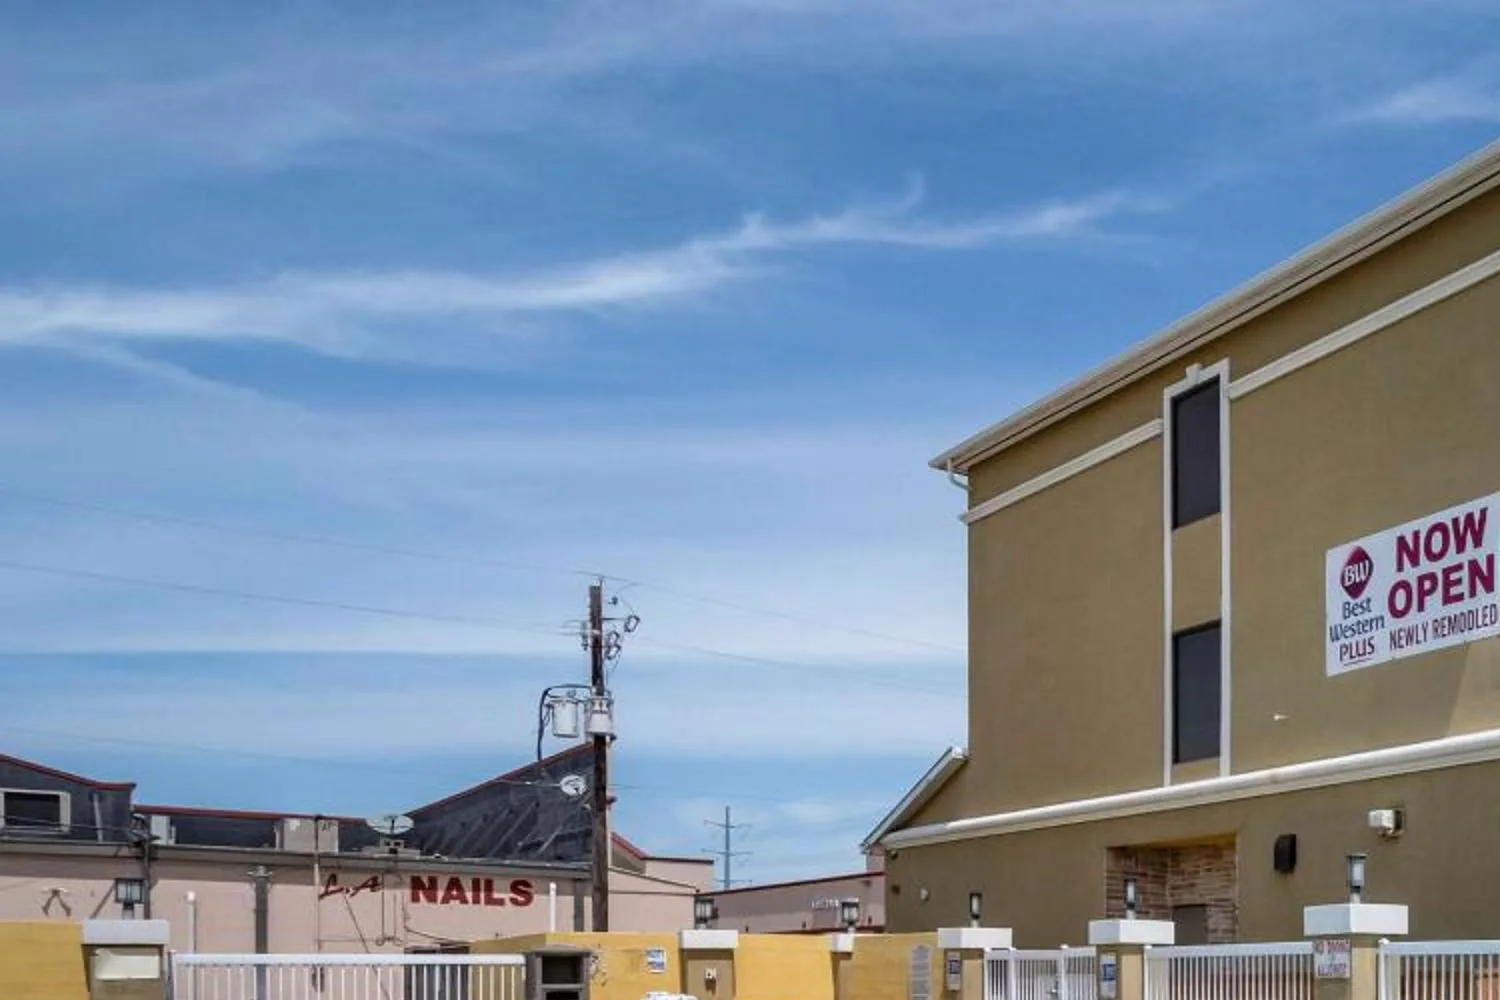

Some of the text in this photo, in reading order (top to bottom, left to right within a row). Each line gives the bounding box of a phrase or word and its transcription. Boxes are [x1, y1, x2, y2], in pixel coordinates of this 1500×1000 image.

[1395, 507, 1488, 573] NOW
[1343, 559, 1370, 587] BW
[1387, 553, 1495, 619] OPEN
[1343, 597, 1372, 620] Best
[1330, 615, 1385, 643] Western
[1389, 603, 1498, 652] NEWLY REMODLED
[1339, 635, 1375, 662] PLUS
[409, 875, 534, 907] NAILS
